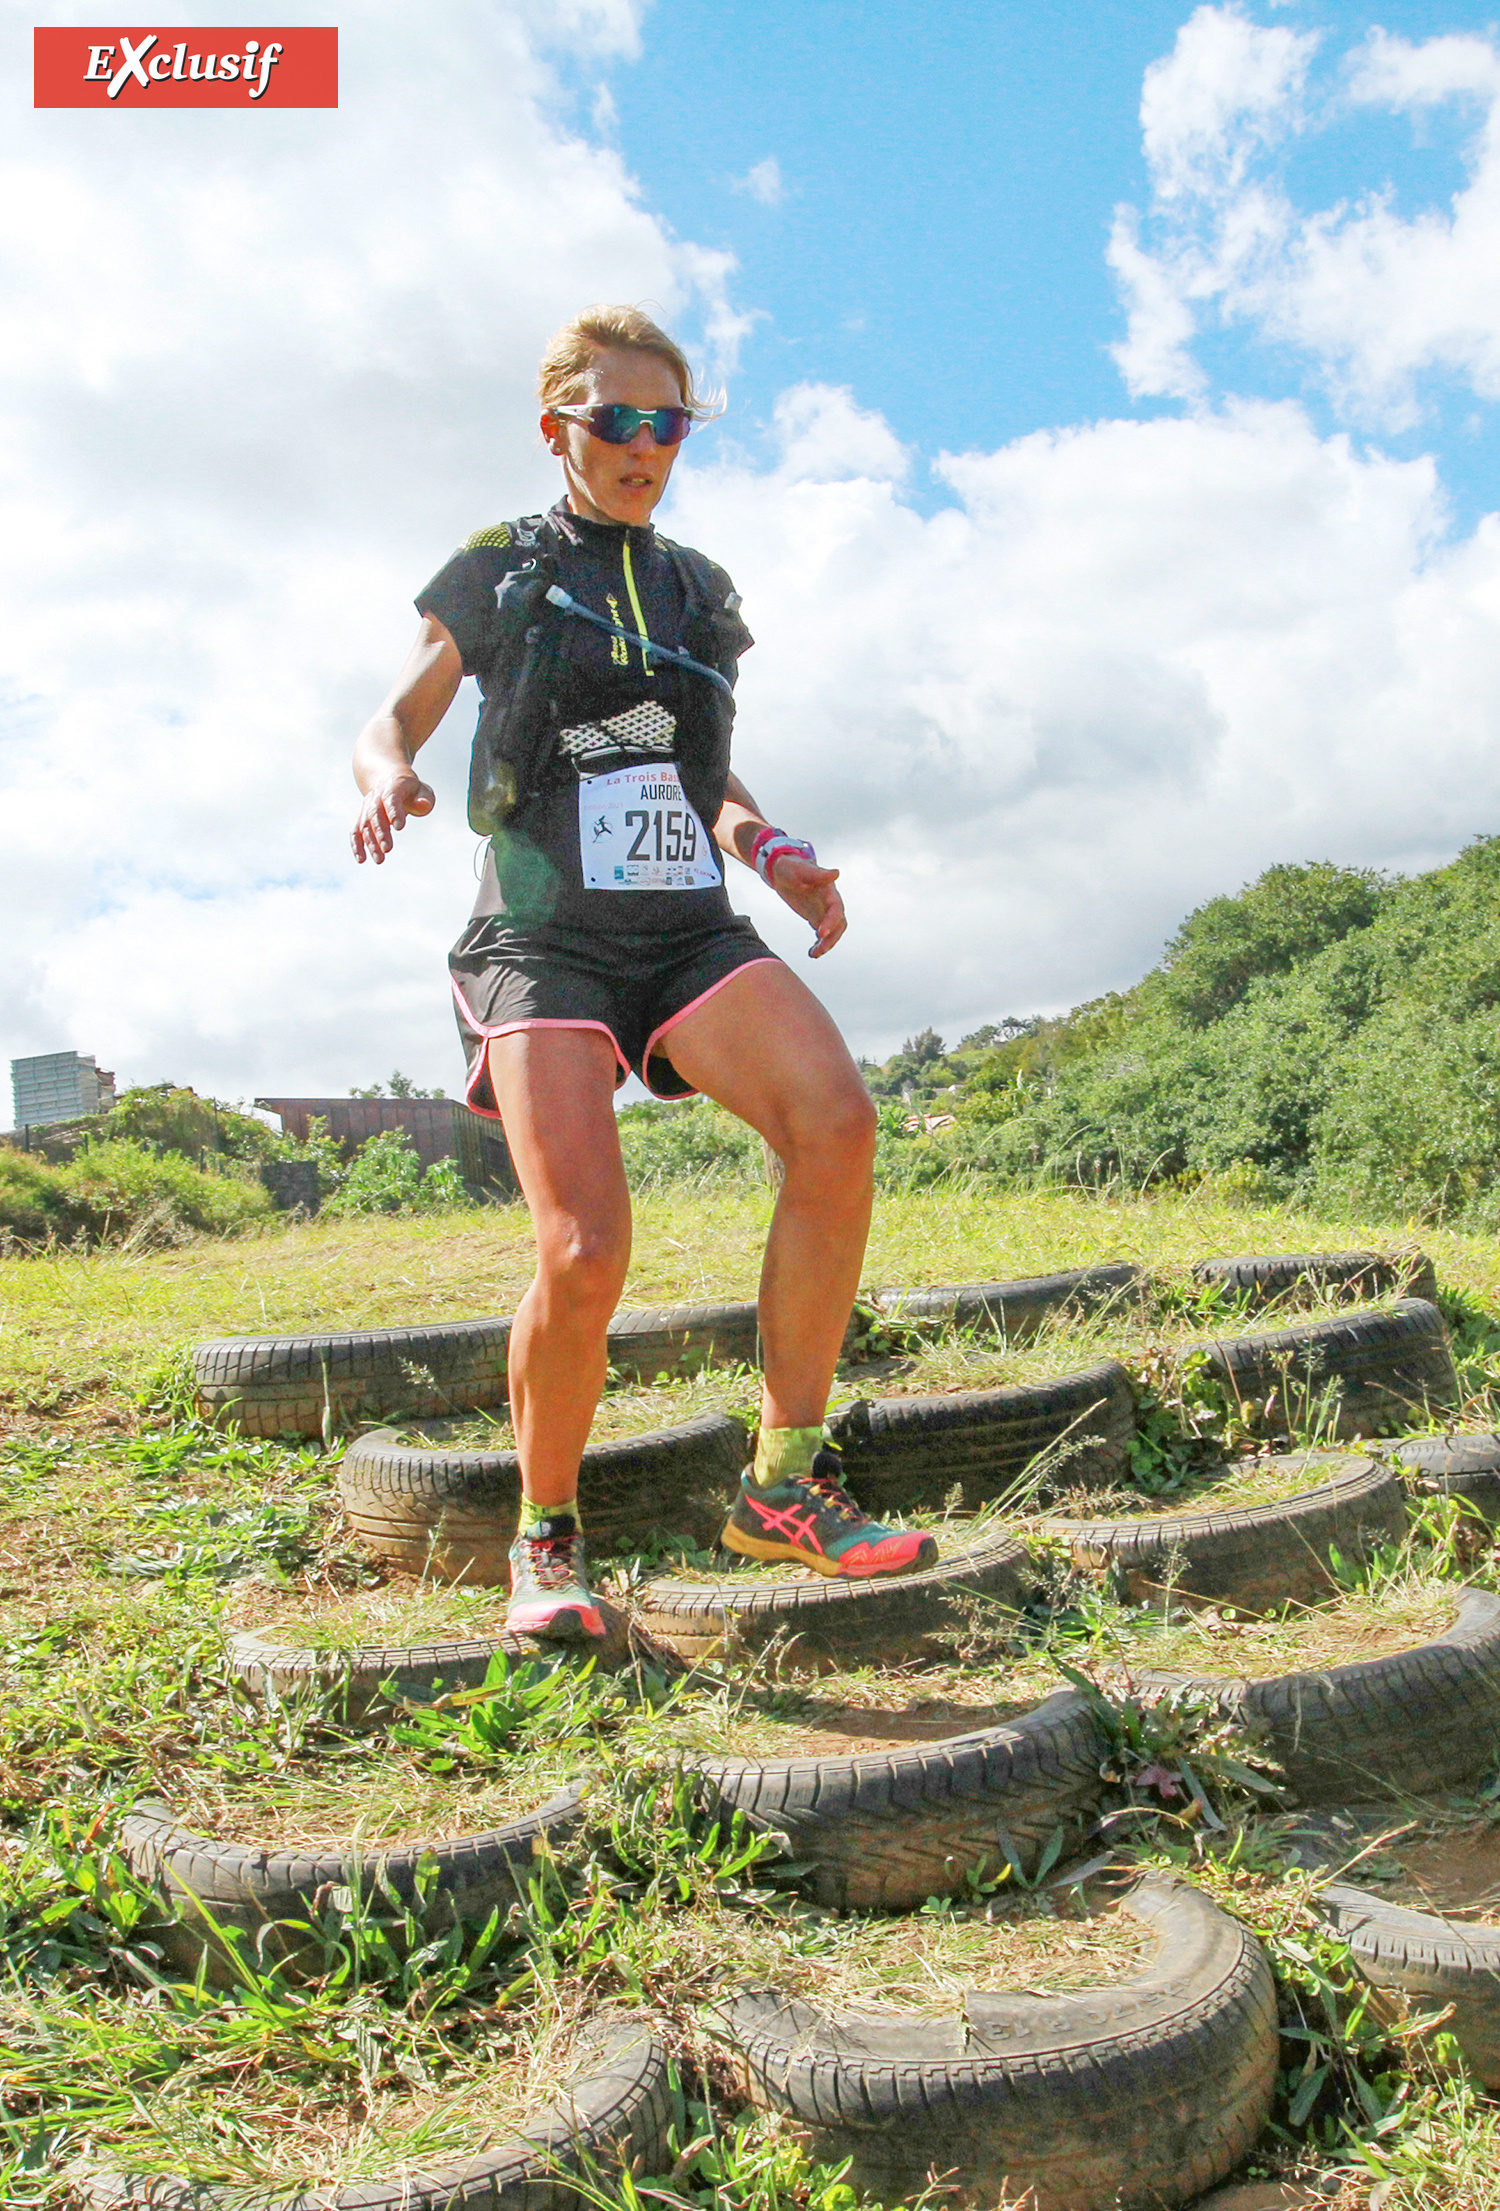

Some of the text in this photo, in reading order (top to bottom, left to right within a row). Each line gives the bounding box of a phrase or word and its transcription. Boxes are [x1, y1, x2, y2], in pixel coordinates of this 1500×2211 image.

[606, 777, 621, 786] La
[624, 771, 657, 783] Trois
[640, 784, 682, 801] AURORE
[625, 810, 697, 862] 2159
[985, 2018, 1031, 2041] 13
